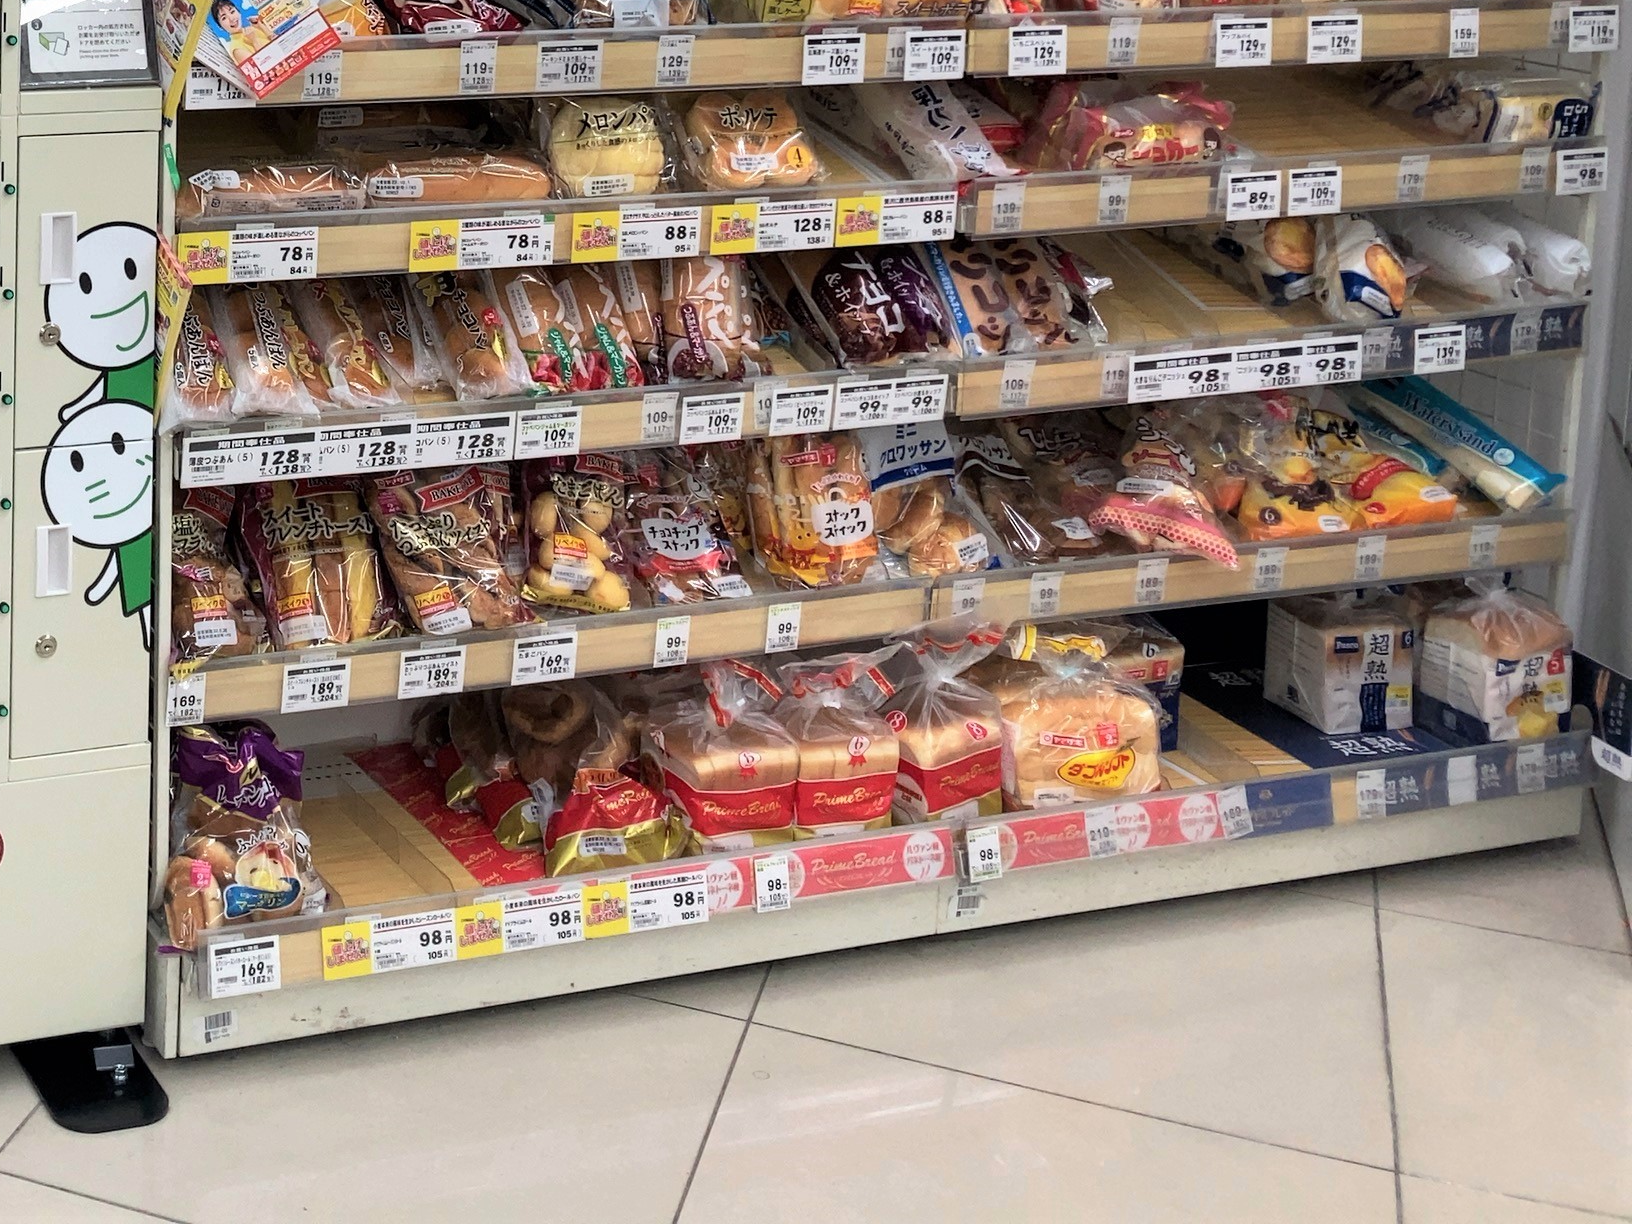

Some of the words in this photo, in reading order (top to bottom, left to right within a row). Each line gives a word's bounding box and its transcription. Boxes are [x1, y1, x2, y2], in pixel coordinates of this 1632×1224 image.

[768, 5, 808, 17] 蒸しケーキ
[720, 105, 779, 129] ポルテ
[794, 218, 822, 232] 128
[923, 209, 944, 224] 88
[664, 224, 688, 240] 88
[507, 234, 530, 249] 78
[279, 246, 304, 262] 78
[454, 281, 487, 351] チョコパン
[251, 288, 287, 371] つぶあんぱん
[378, 332, 393, 353] 5個入
[247, 346, 259, 372] 5個入
[175, 363, 186, 387] 5個入
[896, 425, 918, 441] ミニ
[218, 435, 286, 450] 期間奉仕品
[260, 449, 301, 466] 128
[879, 438, 948, 467] クロワッサン
[551, 476, 624, 508] たまごぱん
[262, 503, 325, 523] スイート
[826, 507, 861, 521] スナック
[388, 512, 455, 535] たっぷり
[648, 522, 704, 539] チョコチップ
[824, 520, 867, 539] スティック
[265, 518, 371, 549] フレンチトースト
[661, 536, 701, 551] スナック
[1363, 631, 1391, 682] 超熟
[1059, 735, 1085, 748] ヤマザキ
[1330, 733, 1407, 759] 超熟
[1385, 779, 1420, 802] 超熟
[673, 891, 695, 908] 98
[549, 911, 572, 927] 98
[419, 929, 442, 947] 98
